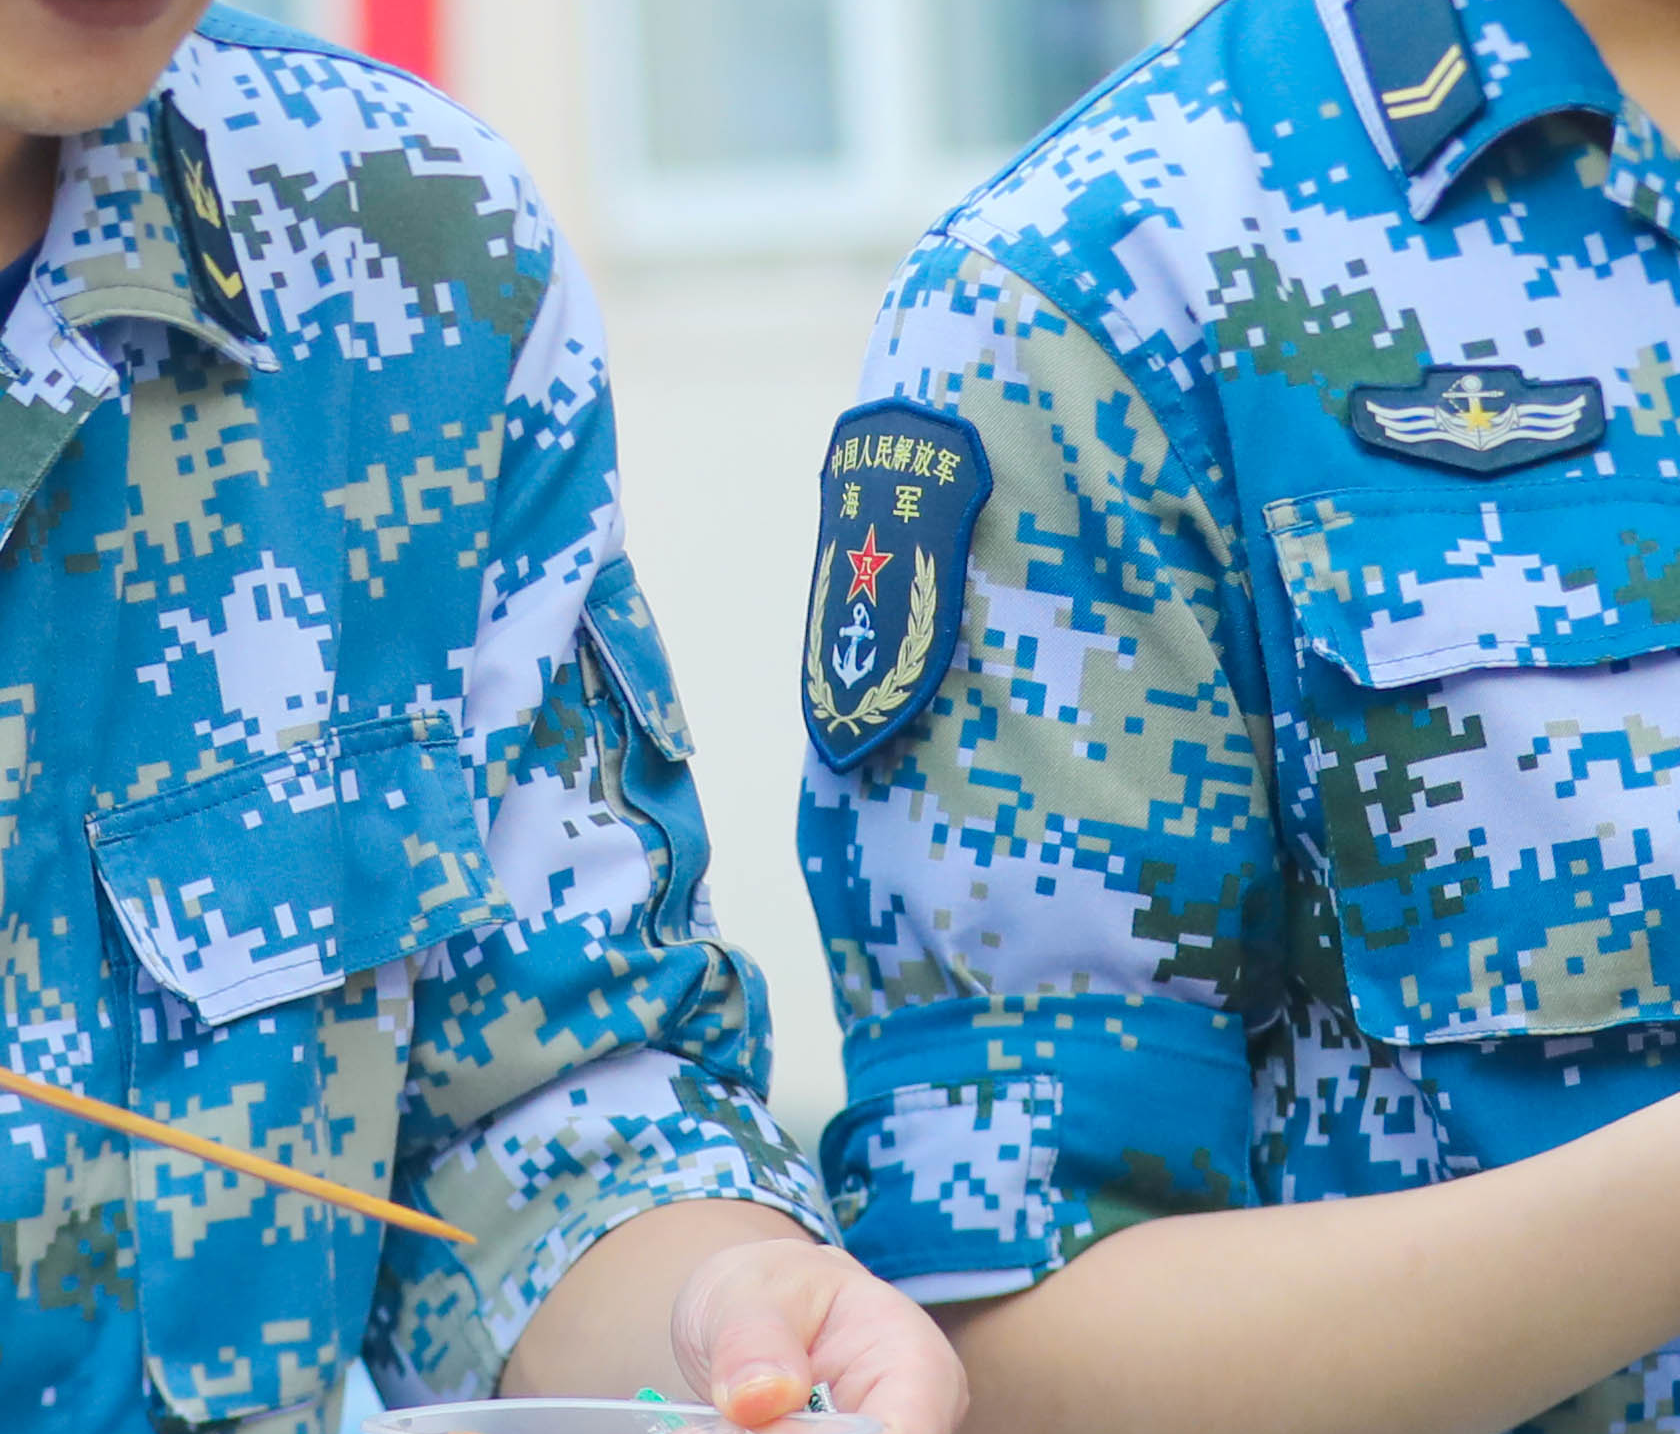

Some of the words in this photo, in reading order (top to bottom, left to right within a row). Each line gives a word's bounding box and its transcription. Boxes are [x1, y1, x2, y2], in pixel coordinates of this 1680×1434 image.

[831, 434, 961, 486] 中国人民解放军
[839, 481, 923, 523] 海军
